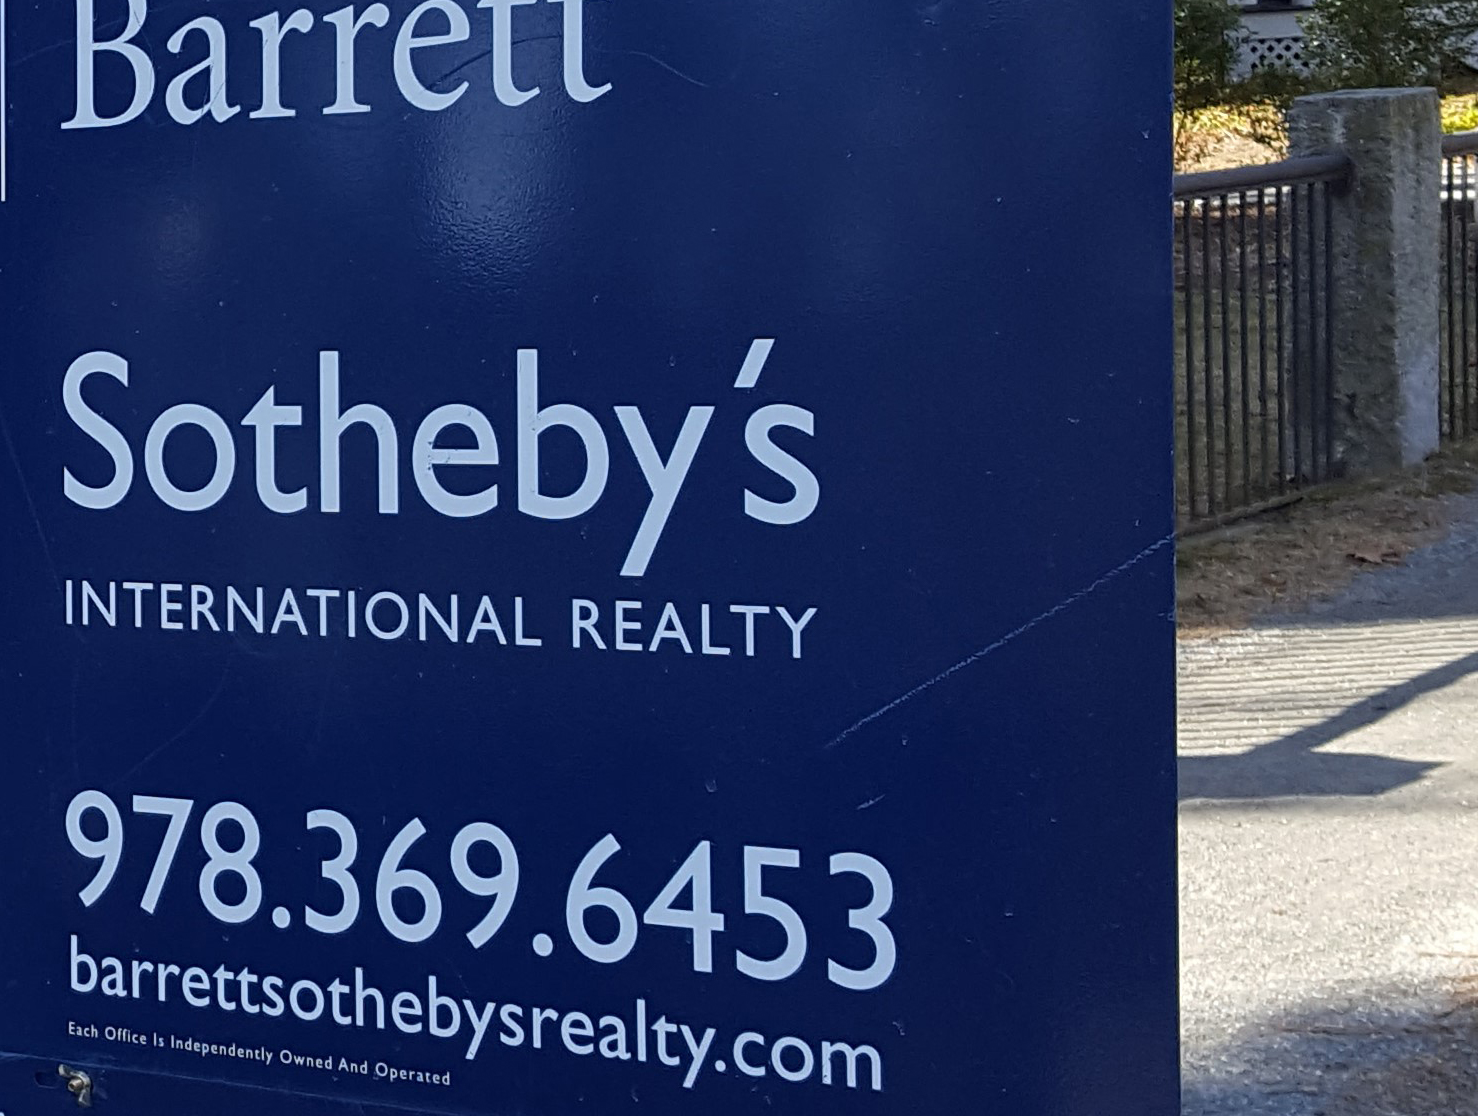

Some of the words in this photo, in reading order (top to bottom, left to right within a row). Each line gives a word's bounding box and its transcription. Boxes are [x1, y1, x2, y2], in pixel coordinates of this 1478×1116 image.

[63, 339, 820, 576] Sotheby's
[65, 580, 542, 647] INTERNATIONAL
[573, 599, 818, 658] REALTY
[65, 790, 897, 989] 978.369.6453
[68, 1021, 98, 1038] Each
[104, 1026, 147, 1045] Office
[152, 1032, 165, 1047] Is
[170, 1034, 274, 1065] Independently
[279, 1049, 333, 1070] Owned
[338, 1057, 368, 1075] And
[375, 1062, 451, 1086] Operated
[70, 935, 882, 1090] barrettsothebysrealty.com
